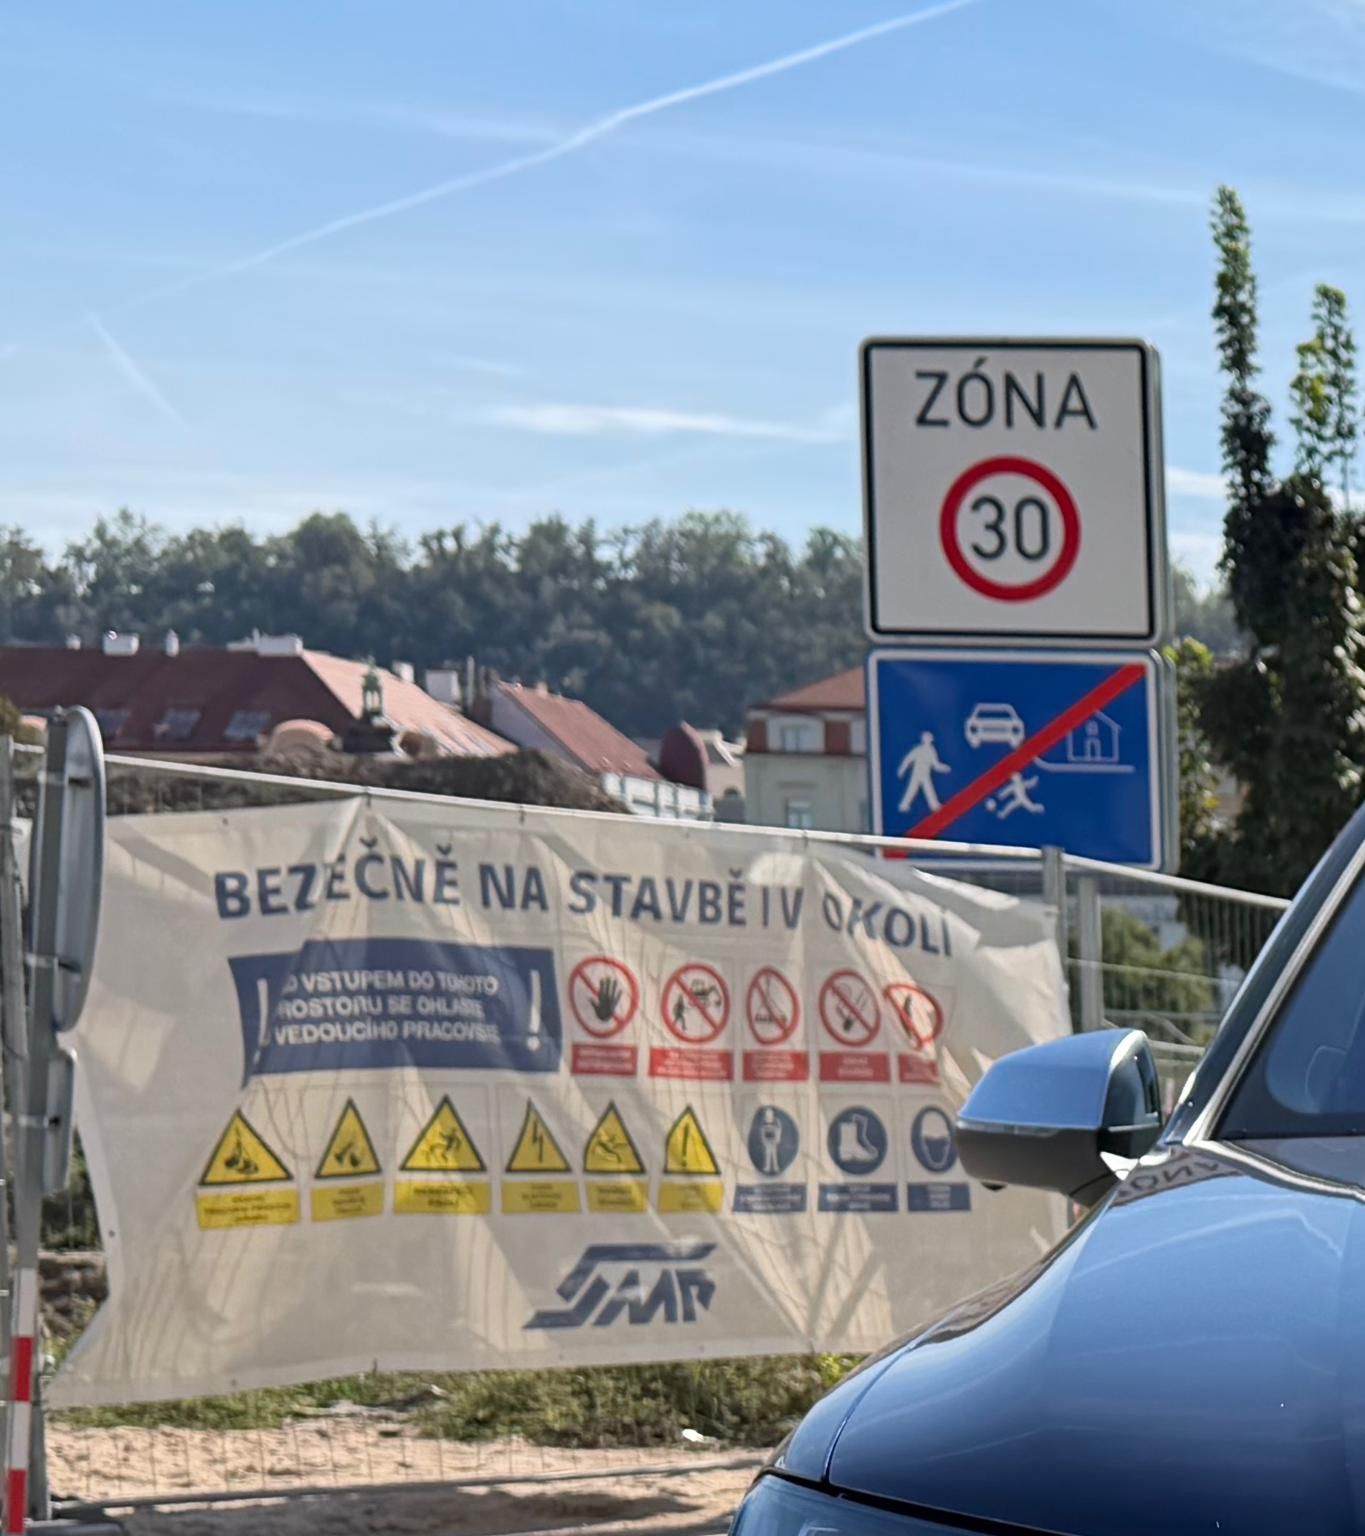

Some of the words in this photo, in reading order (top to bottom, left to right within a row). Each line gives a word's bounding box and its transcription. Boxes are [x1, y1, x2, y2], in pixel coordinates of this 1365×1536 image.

[914, 358, 1097, 430] ZÓNA
[970, 496, 1050, 561] 30
[479, 863, 549, 912] NA
[568, 868, 747, 927] STAVBĚ
[781, 887, 804, 930] V
[301, 969, 405, 993] VSTUPEM
[407, 970, 435, 991] DO
